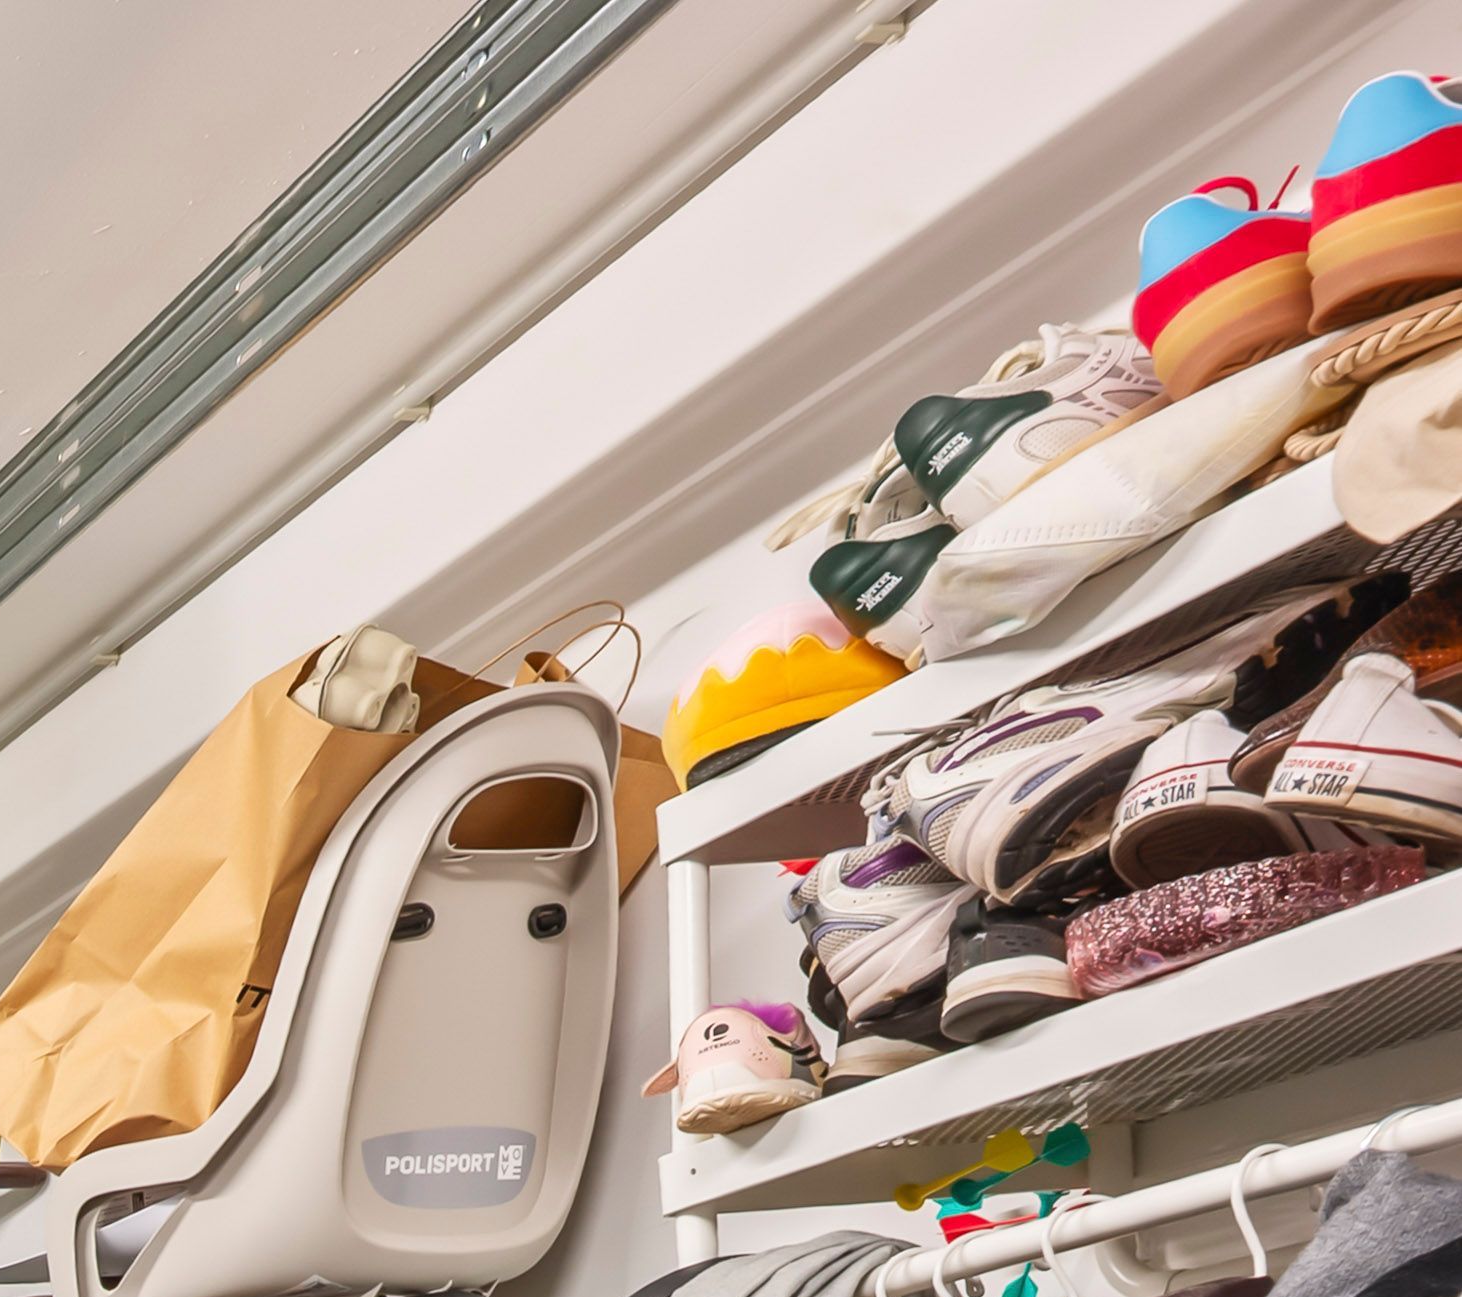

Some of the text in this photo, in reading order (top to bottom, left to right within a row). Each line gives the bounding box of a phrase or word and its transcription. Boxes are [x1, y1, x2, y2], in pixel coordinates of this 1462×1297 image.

[1283, 758, 1358, 772] CONVERSE
[1124, 773, 1198, 804] CONVERSE
[1273, 771, 1349, 798] ALL STAR
[1123, 782, 1195, 823] ALL STAR
[698, 1039, 740, 1055] ARTENGO
[385, 1153, 494, 1175] POLISPORT
